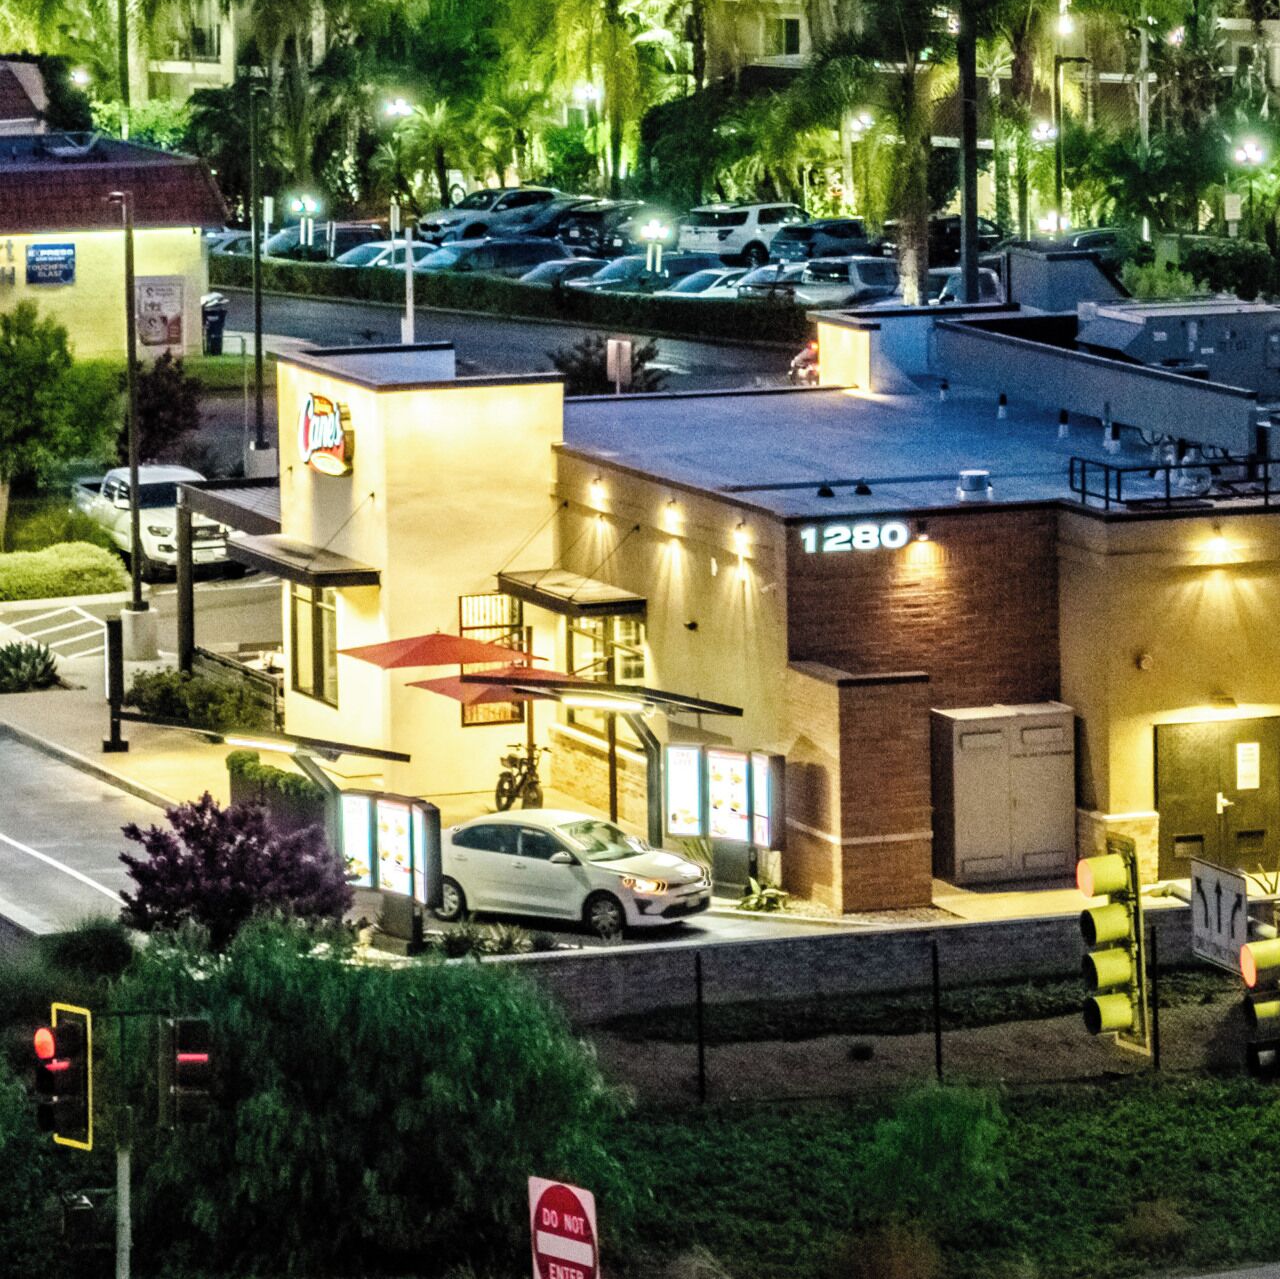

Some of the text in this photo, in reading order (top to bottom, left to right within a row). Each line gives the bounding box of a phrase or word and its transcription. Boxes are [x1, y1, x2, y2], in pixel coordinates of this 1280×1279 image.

[800, 521, 909, 554] 1280
[542, 1207, 585, 1235] DO NOT
